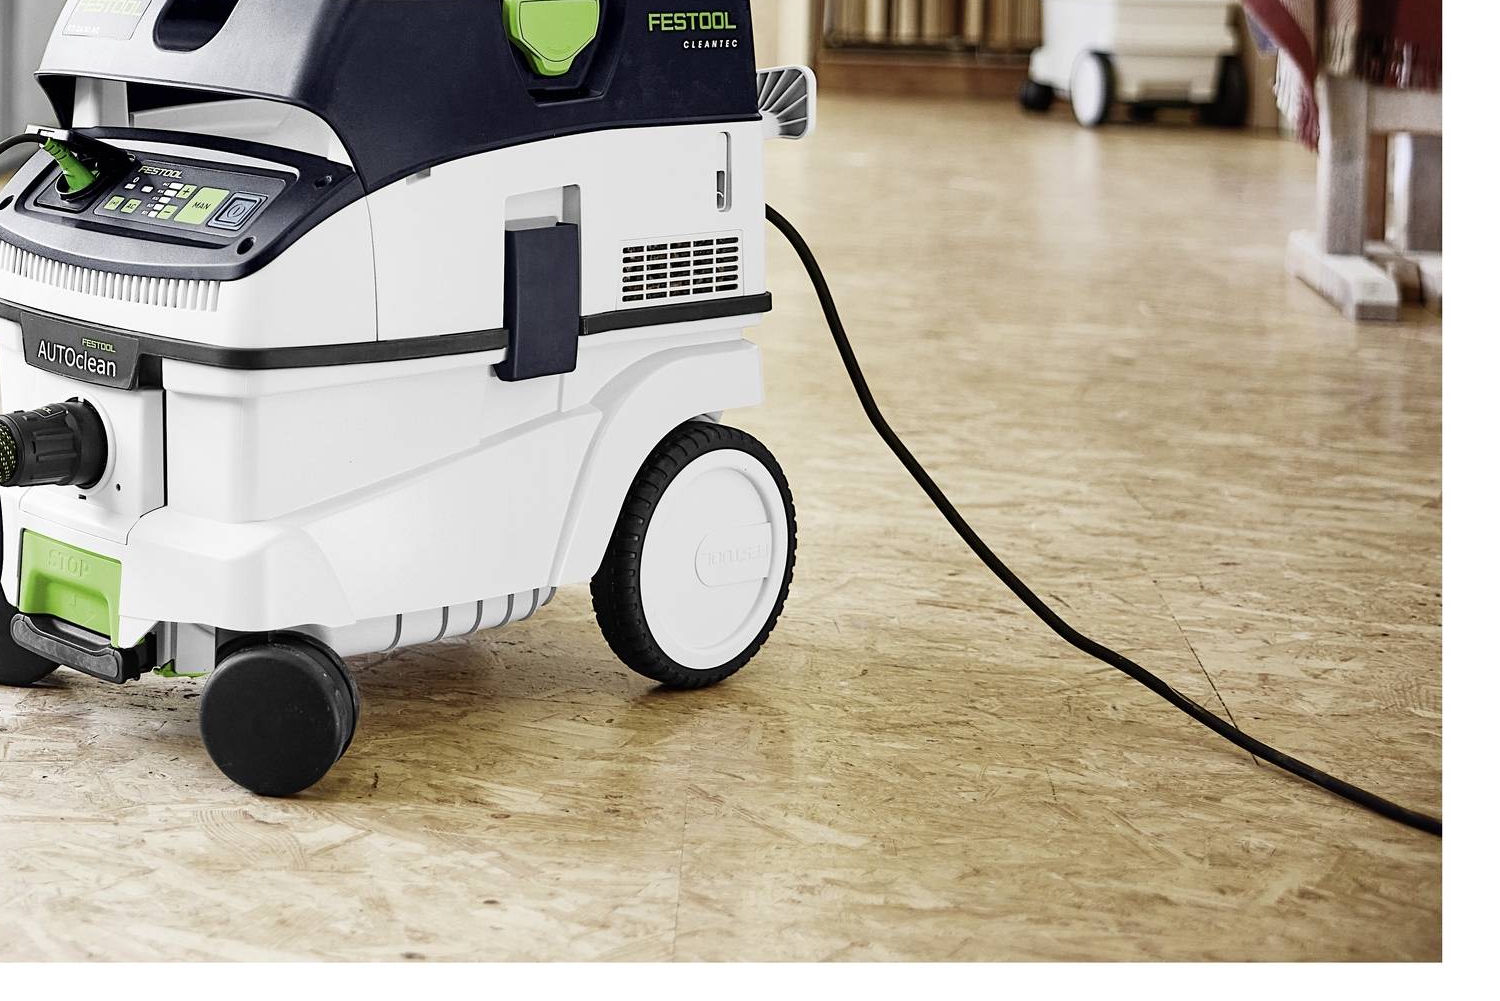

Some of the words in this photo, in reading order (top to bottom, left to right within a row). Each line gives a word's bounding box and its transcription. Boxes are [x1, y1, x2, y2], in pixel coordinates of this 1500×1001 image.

[648, 12, 737, 31] FESTOOL
[683, 40, 738, 49] CLEANTEC
[138, 165, 183, 179] FESTOOL
[191, 201, 212, 210] MAN
[82, 338, 116, 353] FESTOOL
[38, 340, 116, 377] AUTOclean
[47, 549, 90, 577] STOP
